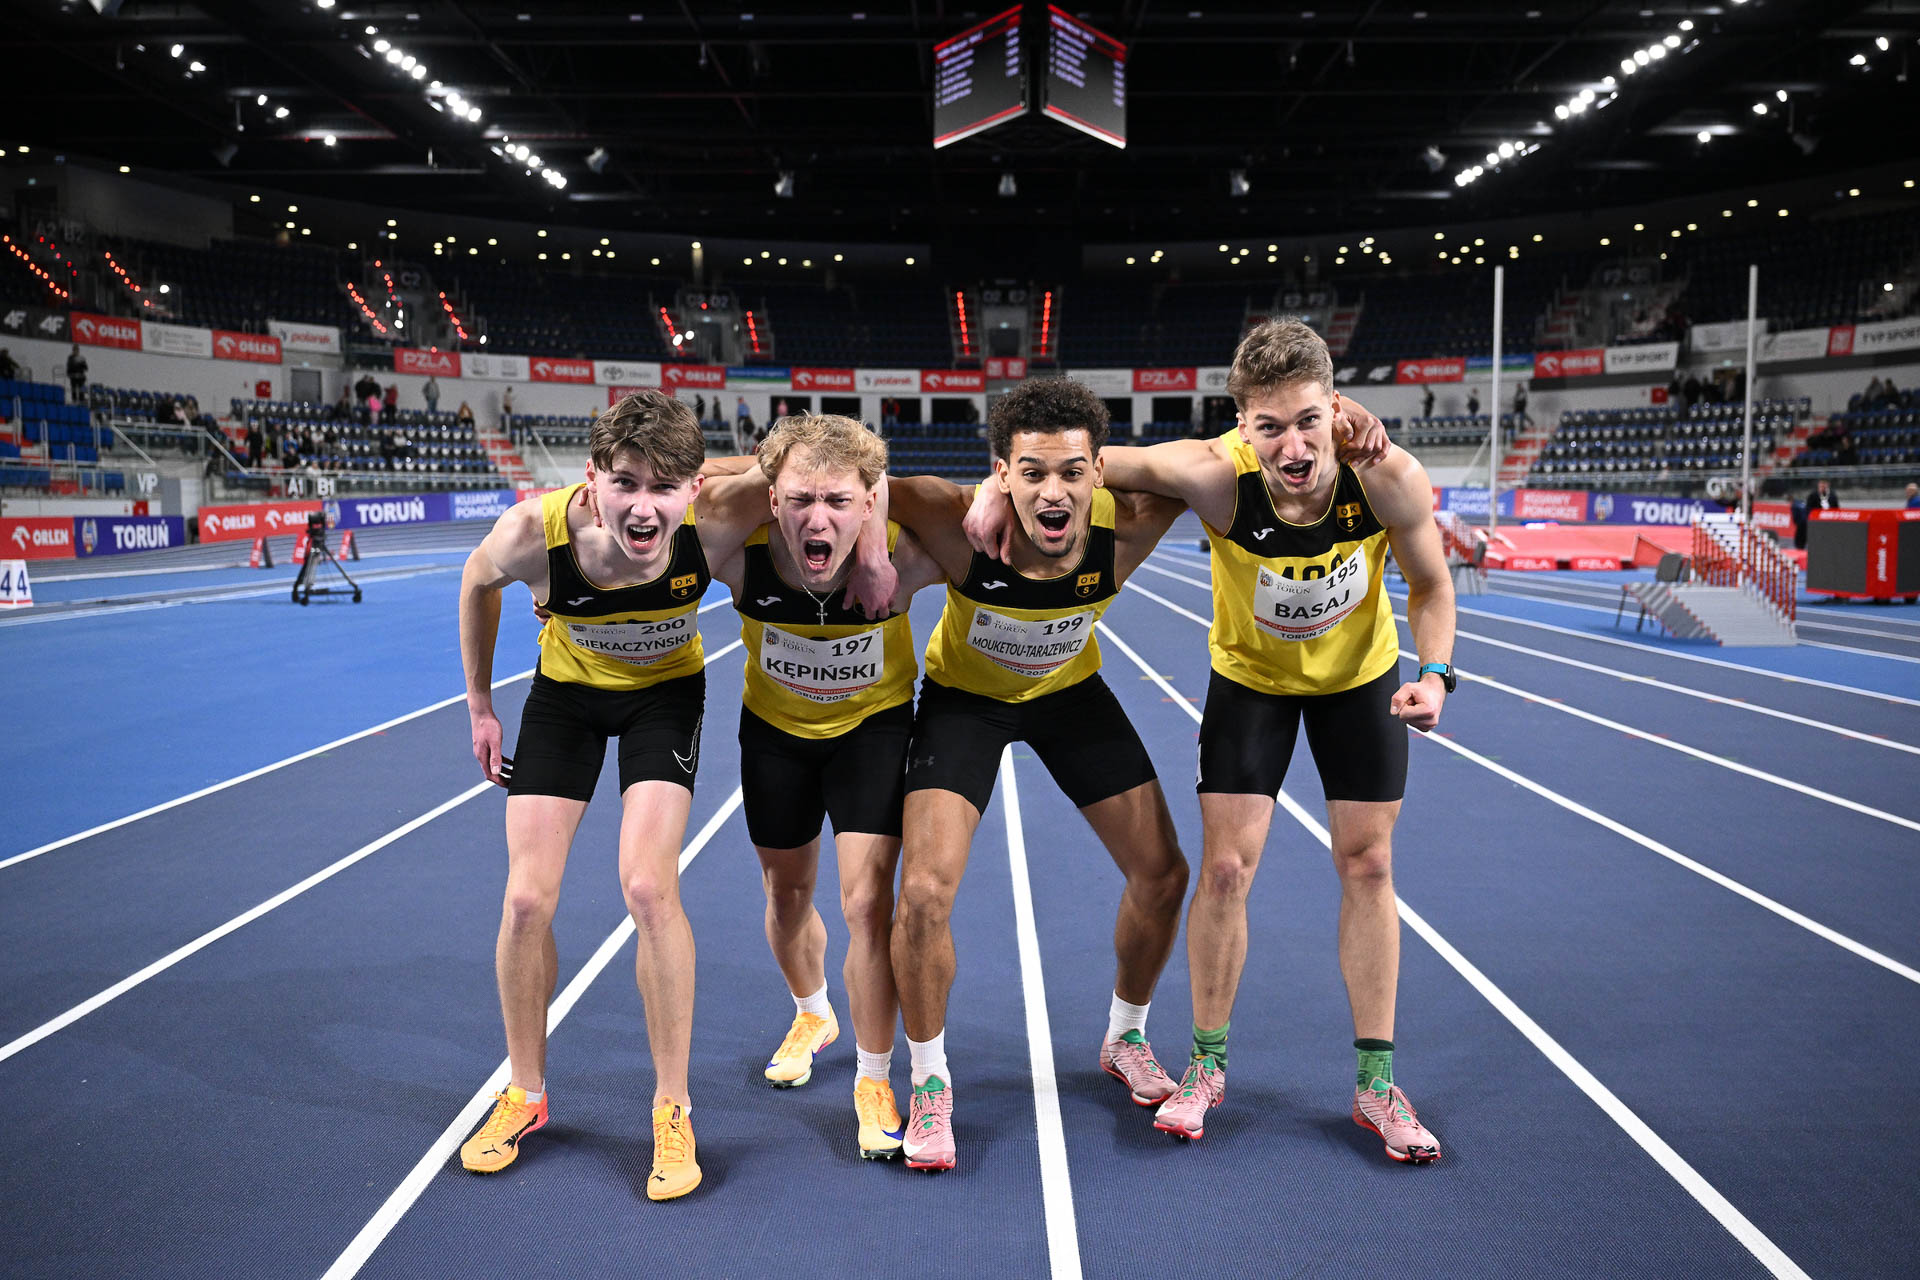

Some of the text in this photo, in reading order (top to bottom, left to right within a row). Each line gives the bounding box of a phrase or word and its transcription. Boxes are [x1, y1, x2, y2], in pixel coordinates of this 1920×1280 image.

[4, 310, 26, 329] 4F
[39, 315, 65, 334] 4F
[99, 323, 137, 340] ORLEN
[238, 340, 277, 355] ORLEN
[403, 352, 451, 369] PZLA
[1561, 356, 1600, 370] ORLEN
[1611, 351, 1671, 366] TVP SPORT
[554, 366, 590, 377] ORLEN
[685, 370, 721, 382] ORLEN
[815, 373, 851, 385] ORLEN
[1140, 371, 1188, 385] PZLA
[944, 375, 981, 387] ORLEN
[287, 477, 304, 495] A1
[317, 477, 335, 496] B1
[454, 491, 500, 505] KUJAWY
[356, 496, 425, 524] TORUŃ
[454, 503, 508, 519] POMORZ
[222, 514, 256, 531] ORLEN
[33, 527, 69, 546] ORLEN
[113, 518, 170, 549] TORUŃ
[1325, 556, 1358, 590] 195
[1274, 589, 1350, 620] BASAJ
[641, 618, 686, 635] 200
[1042, 616, 1084, 636] 199
[1280, 619, 1340, 640] TORUŃ 2026
[575, 633, 691, 652] SIEKACZYŃSKI
[831, 635, 874, 657] 197
[972, 636, 1083, 658] MOUKETOU-TARAZEWICZ
[766, 657, 876, 682] KĘPIŃSKI
[826, 693, 851, 702] 2026
